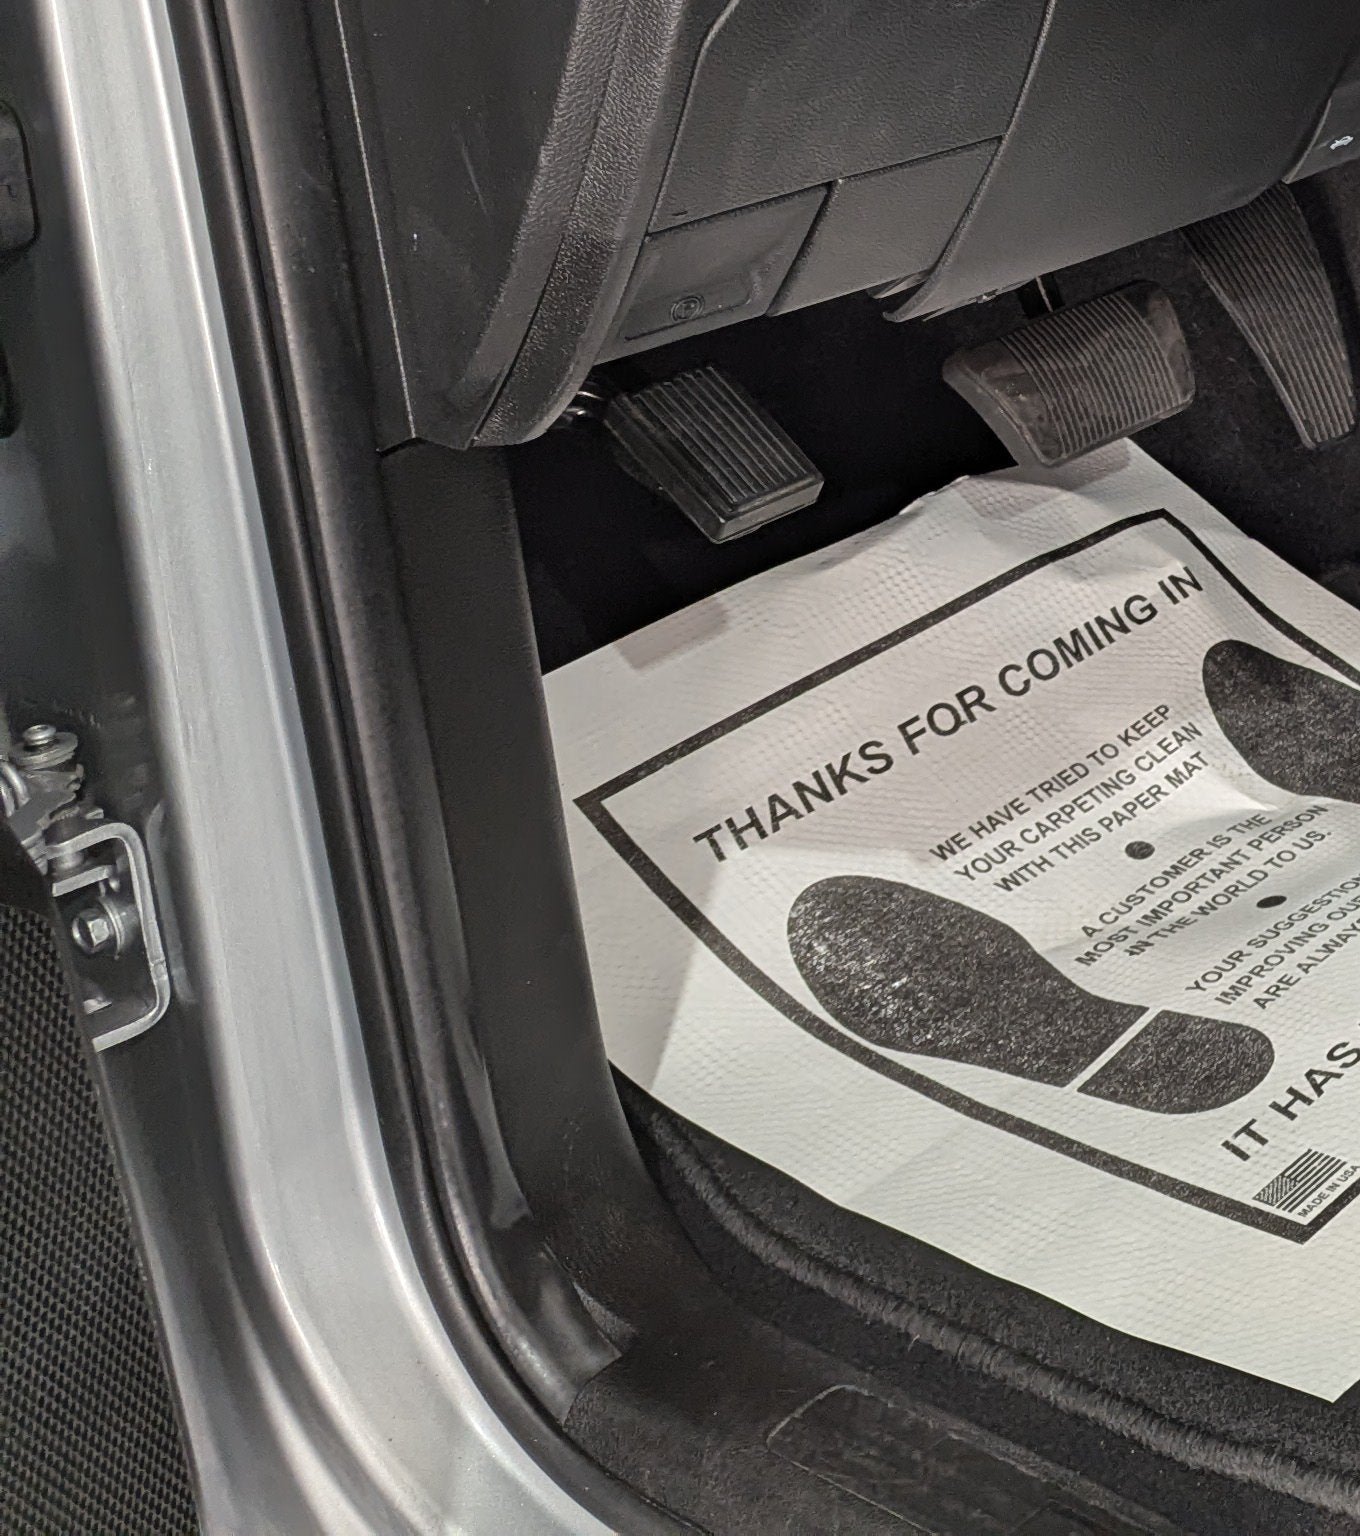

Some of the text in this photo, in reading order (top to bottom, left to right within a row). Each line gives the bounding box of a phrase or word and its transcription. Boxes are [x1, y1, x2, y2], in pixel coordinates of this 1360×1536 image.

[693, 566, 1204, 863] THANKS FOR COMING IN
[929, 704, 1172, 862] WE HAVE TRIED TO KEEP
[954, 721, 1204, 883] YOUR CARPETING CLEAN
[993, 751, 1209, 893] WITH THIS PAPER MAT
[1074, 805, 1329, 967] MOST IMPORTANT PERSON
[1081, 814, 1273, 939] A CUSTOMER IS THE
[1123, 830, 1333, 957] IN THE WORLD TO US.
[1185, 950, 1252, 994] YOUR
[1214, 922, 1330, 1006] IMPROVING
[1253, 972, 1302, 1010] ARE
[1220, 1118, 1270, 1162] IT
[1297, 1191, 1331, 1218] MADE
[1326, 1181, 1341, 1193] IN
